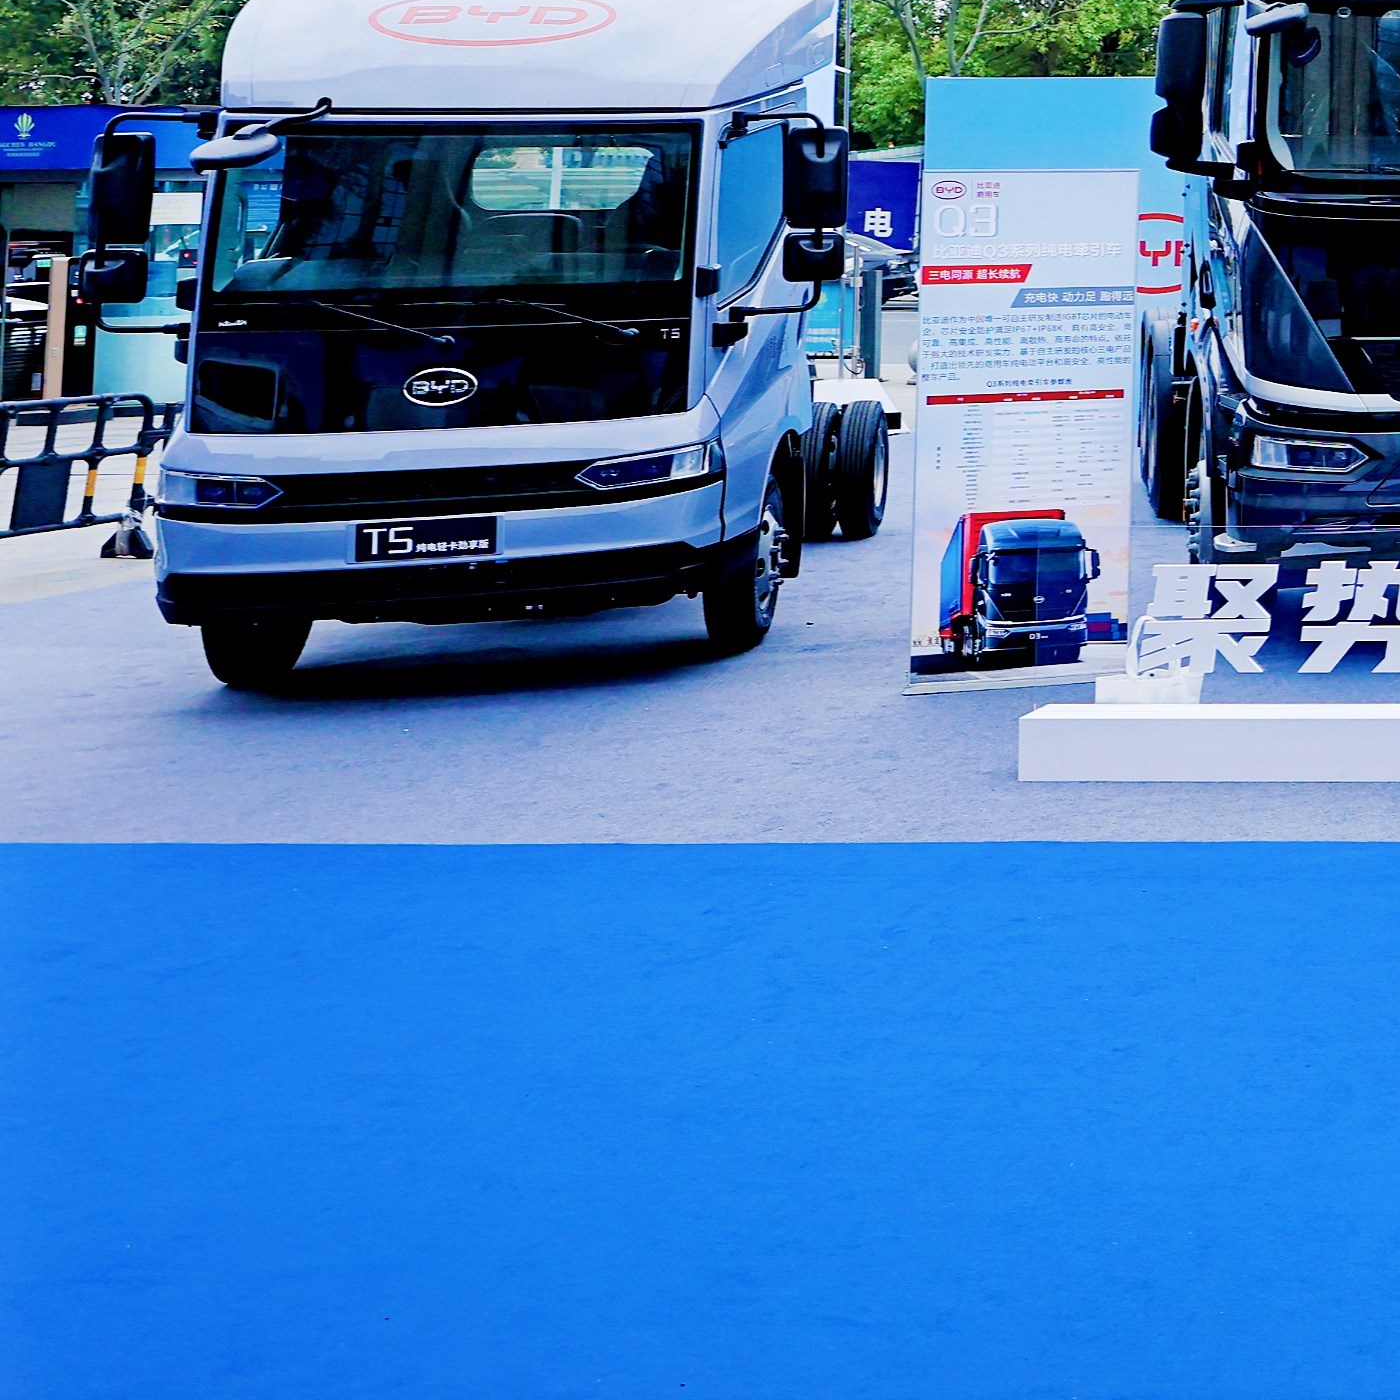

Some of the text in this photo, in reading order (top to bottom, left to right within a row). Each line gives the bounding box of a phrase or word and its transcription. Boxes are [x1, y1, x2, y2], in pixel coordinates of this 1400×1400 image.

[399, 5, 589, 25] BYD
[976, 182, 1001, 190] 比亚迪
[863, 207, 894, 239] 电
[933, 204, 998, 238] Q3
[932, 242, 1122, 261] 比亚迪Q3系列纯电牵引车
[928, 268, 1022, 281] 三电同源 超长续航
[1024, 290, 1134, 303] 充电快 动力足 跑得远
[660, 328, 681, 339] T5
[362, 526, 414, 555] T5
